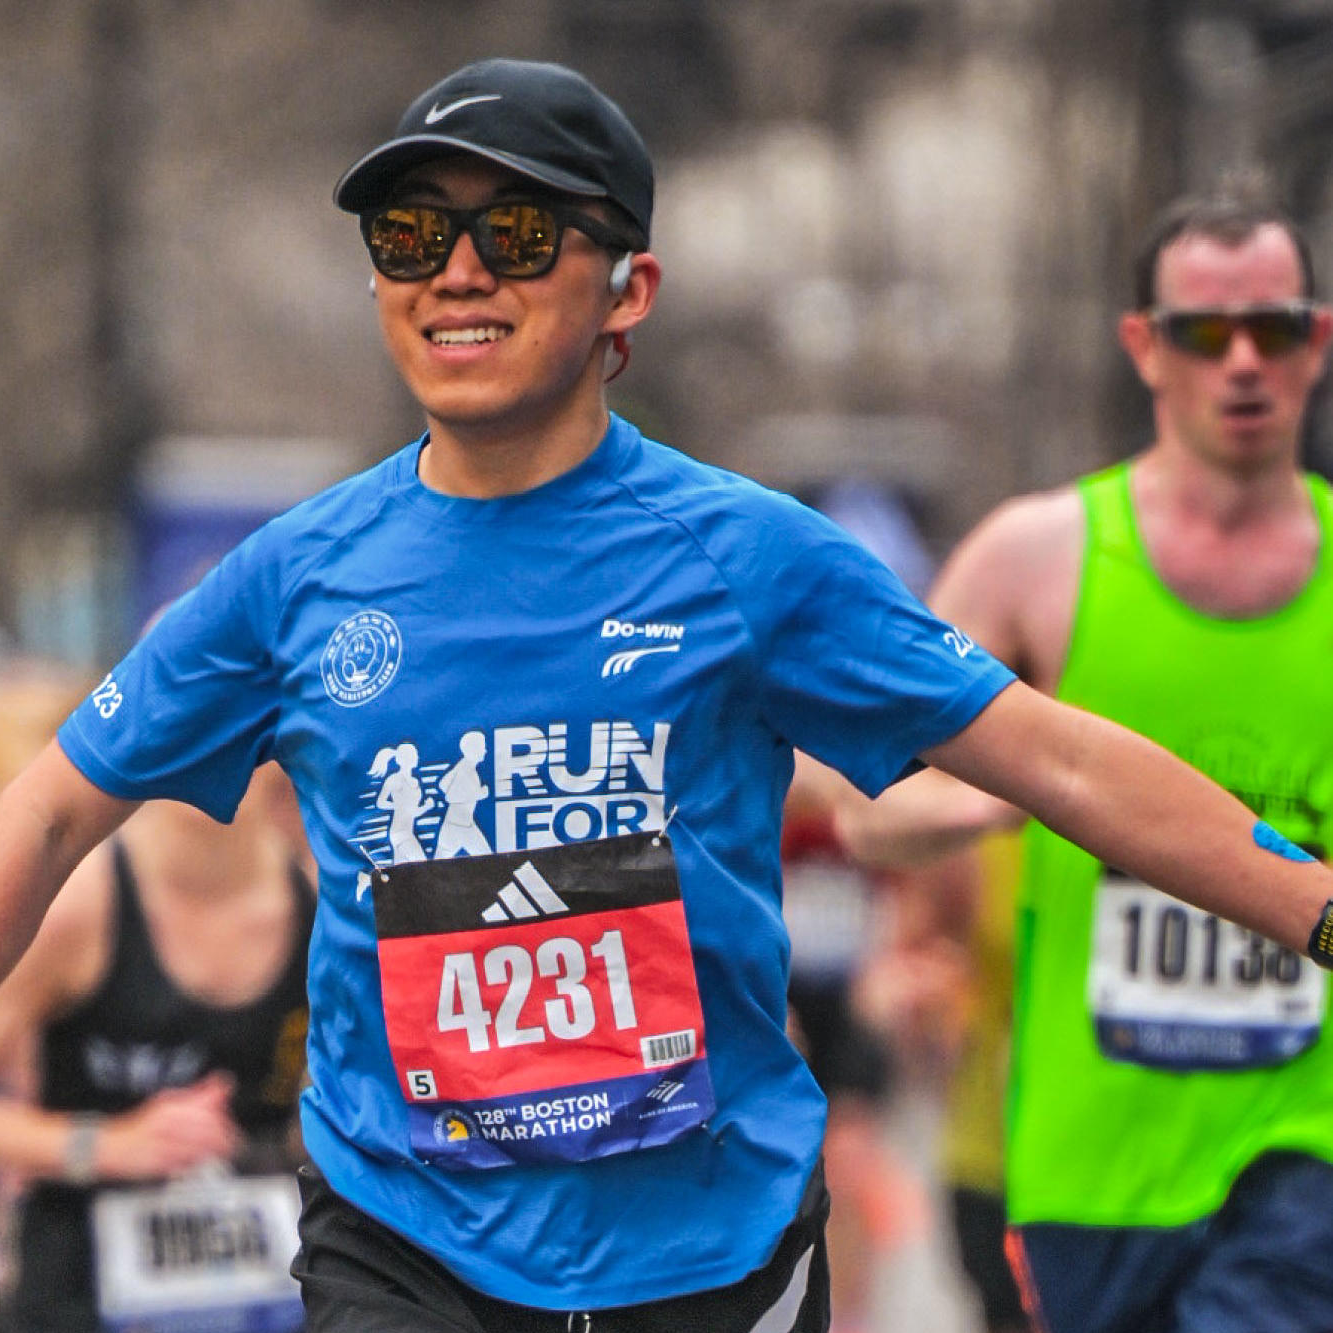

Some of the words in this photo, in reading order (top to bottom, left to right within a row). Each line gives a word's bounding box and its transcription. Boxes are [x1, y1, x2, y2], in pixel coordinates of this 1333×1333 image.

[91, 672, 123, 719] 23
[493, 720, 671, 797] RUN
[515, 801, 649, 850] FOR
[437, 929, 638, 1053] 4231
[414, 1074, 431, 1096] 5
[521, 1092, 609, 1121] BOSTON
[481, 1110, 611, 1140] MARATHON
